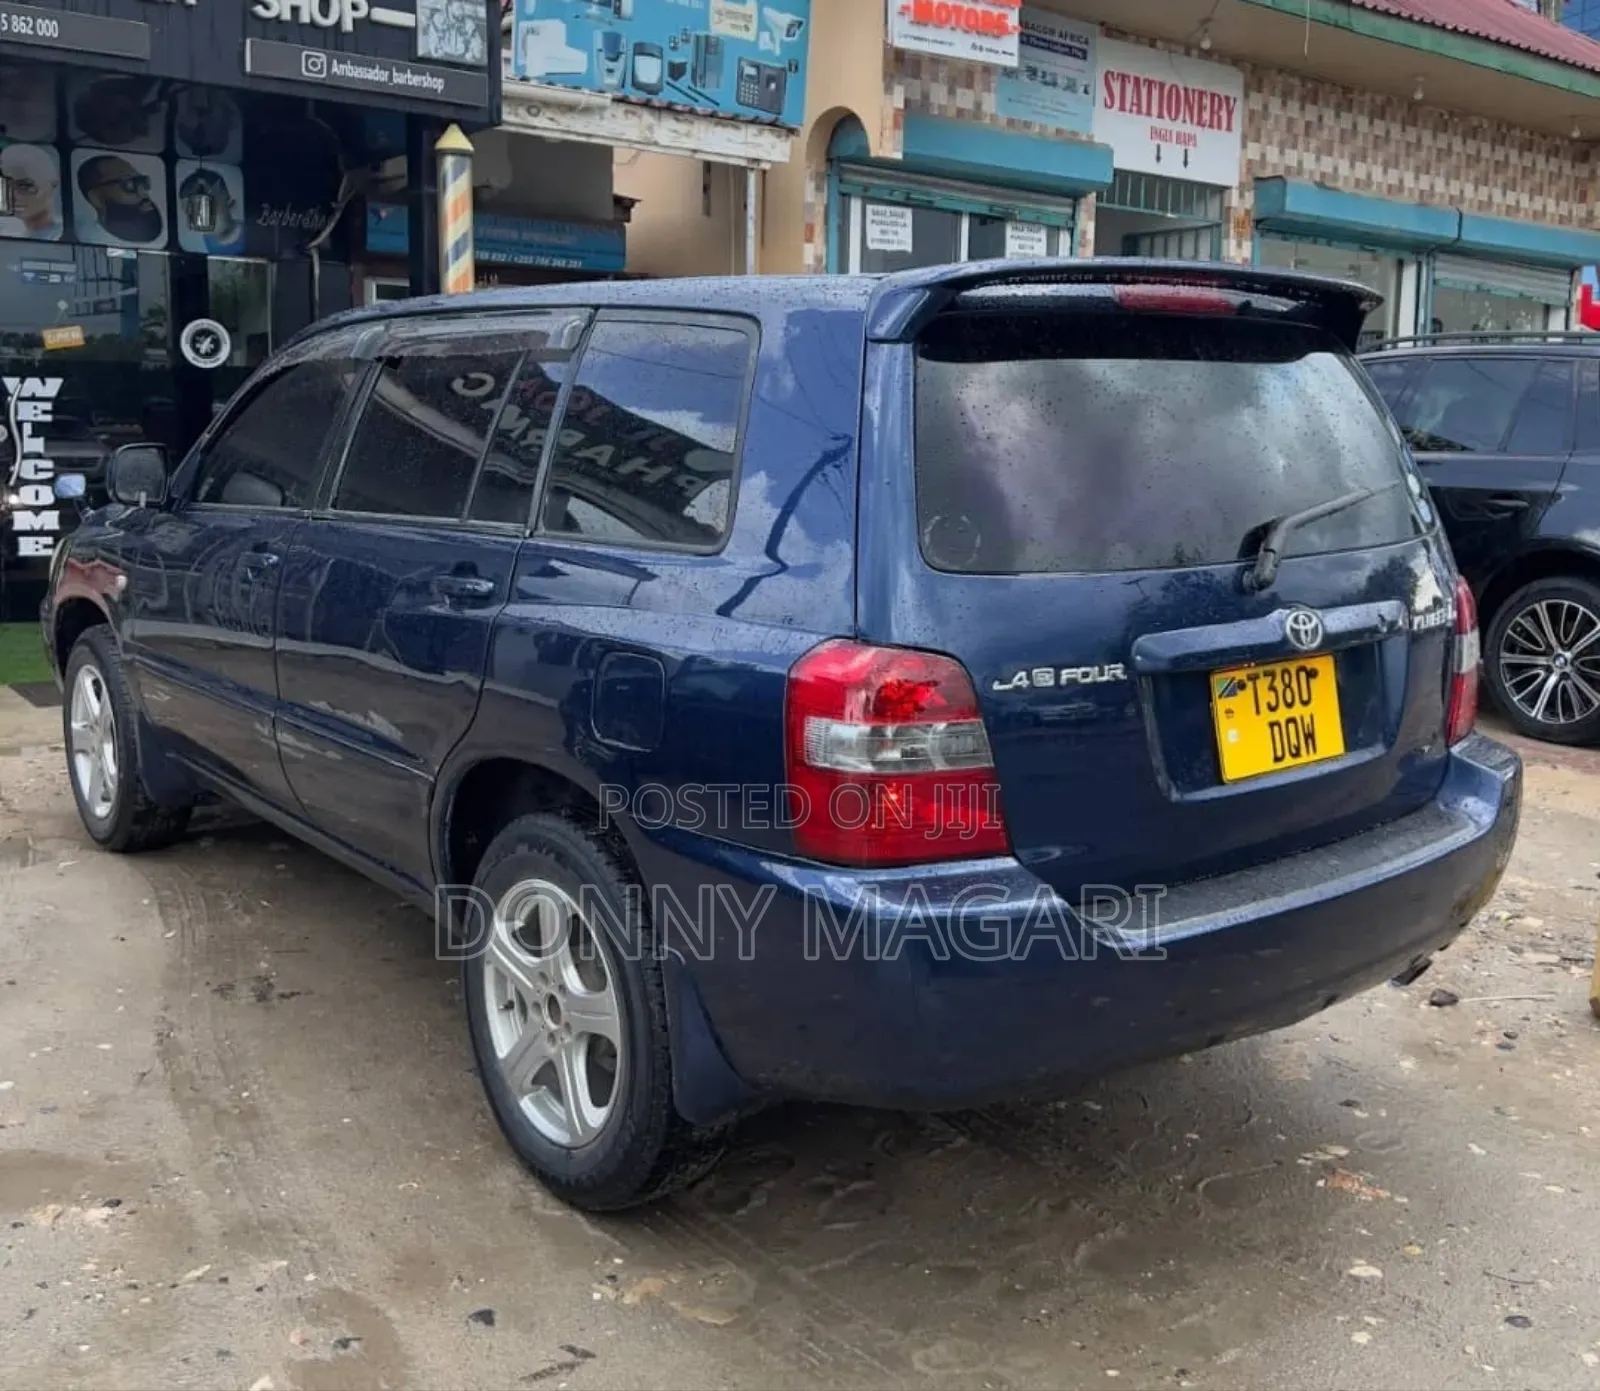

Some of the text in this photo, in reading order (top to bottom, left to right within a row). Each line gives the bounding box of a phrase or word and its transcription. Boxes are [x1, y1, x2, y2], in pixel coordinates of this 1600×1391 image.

[12, 14, 34, 35] 862
[36, 18, 59, 38] 000
[331, 58, 444, 94] Ambassador_barbershop
[1104, 69, 1237, 133] STATIONERY
[2, 377, 64, 557] WELCOME
[1060, 662, 1127, 686] FOUR
[1246, 664, 1312, 716] T380
[1268, 713, 1317, 763] DQW
